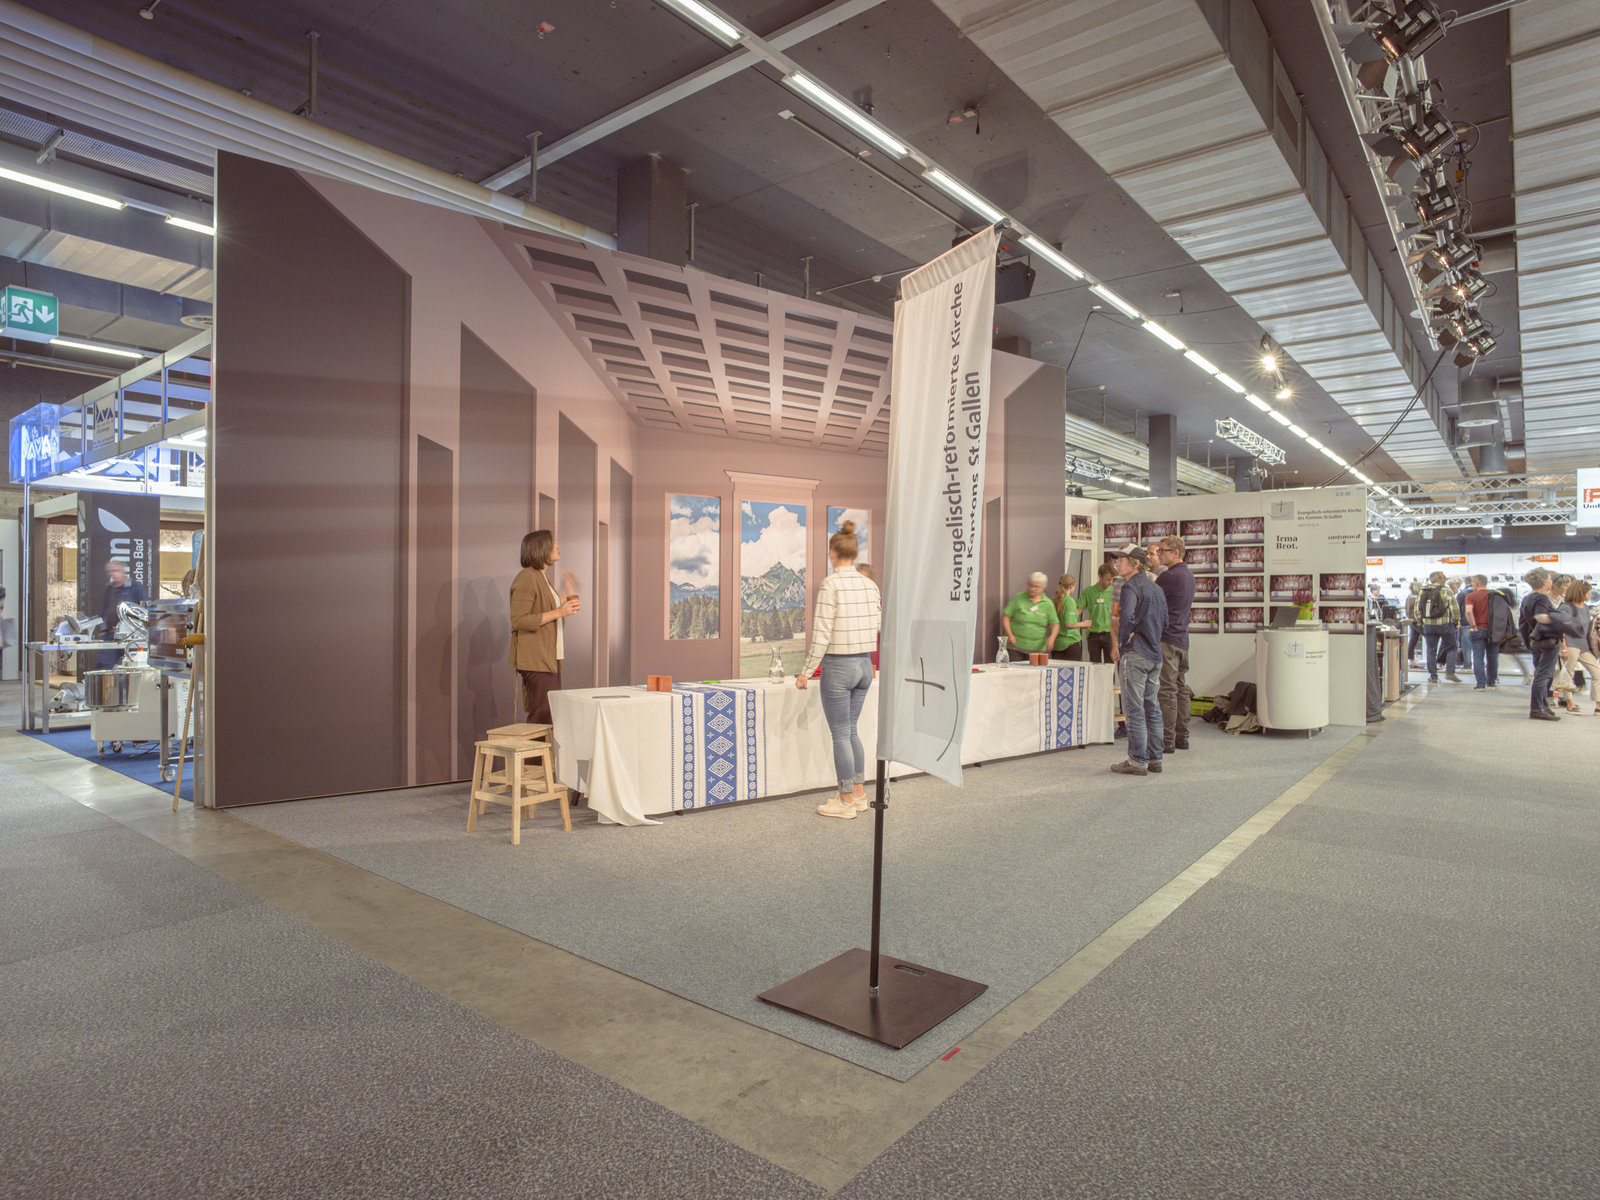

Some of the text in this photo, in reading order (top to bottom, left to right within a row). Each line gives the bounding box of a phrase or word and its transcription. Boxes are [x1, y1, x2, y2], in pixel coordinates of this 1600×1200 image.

[943, 281, 966, 602] Evangelisch-reformierte Kirche
[966, 473, 979, 559] Kantons
[133, 538, 144, 559] Bad
[1275, 542, 1299, 550] Brot.
[963, 566, 973, 602] des
